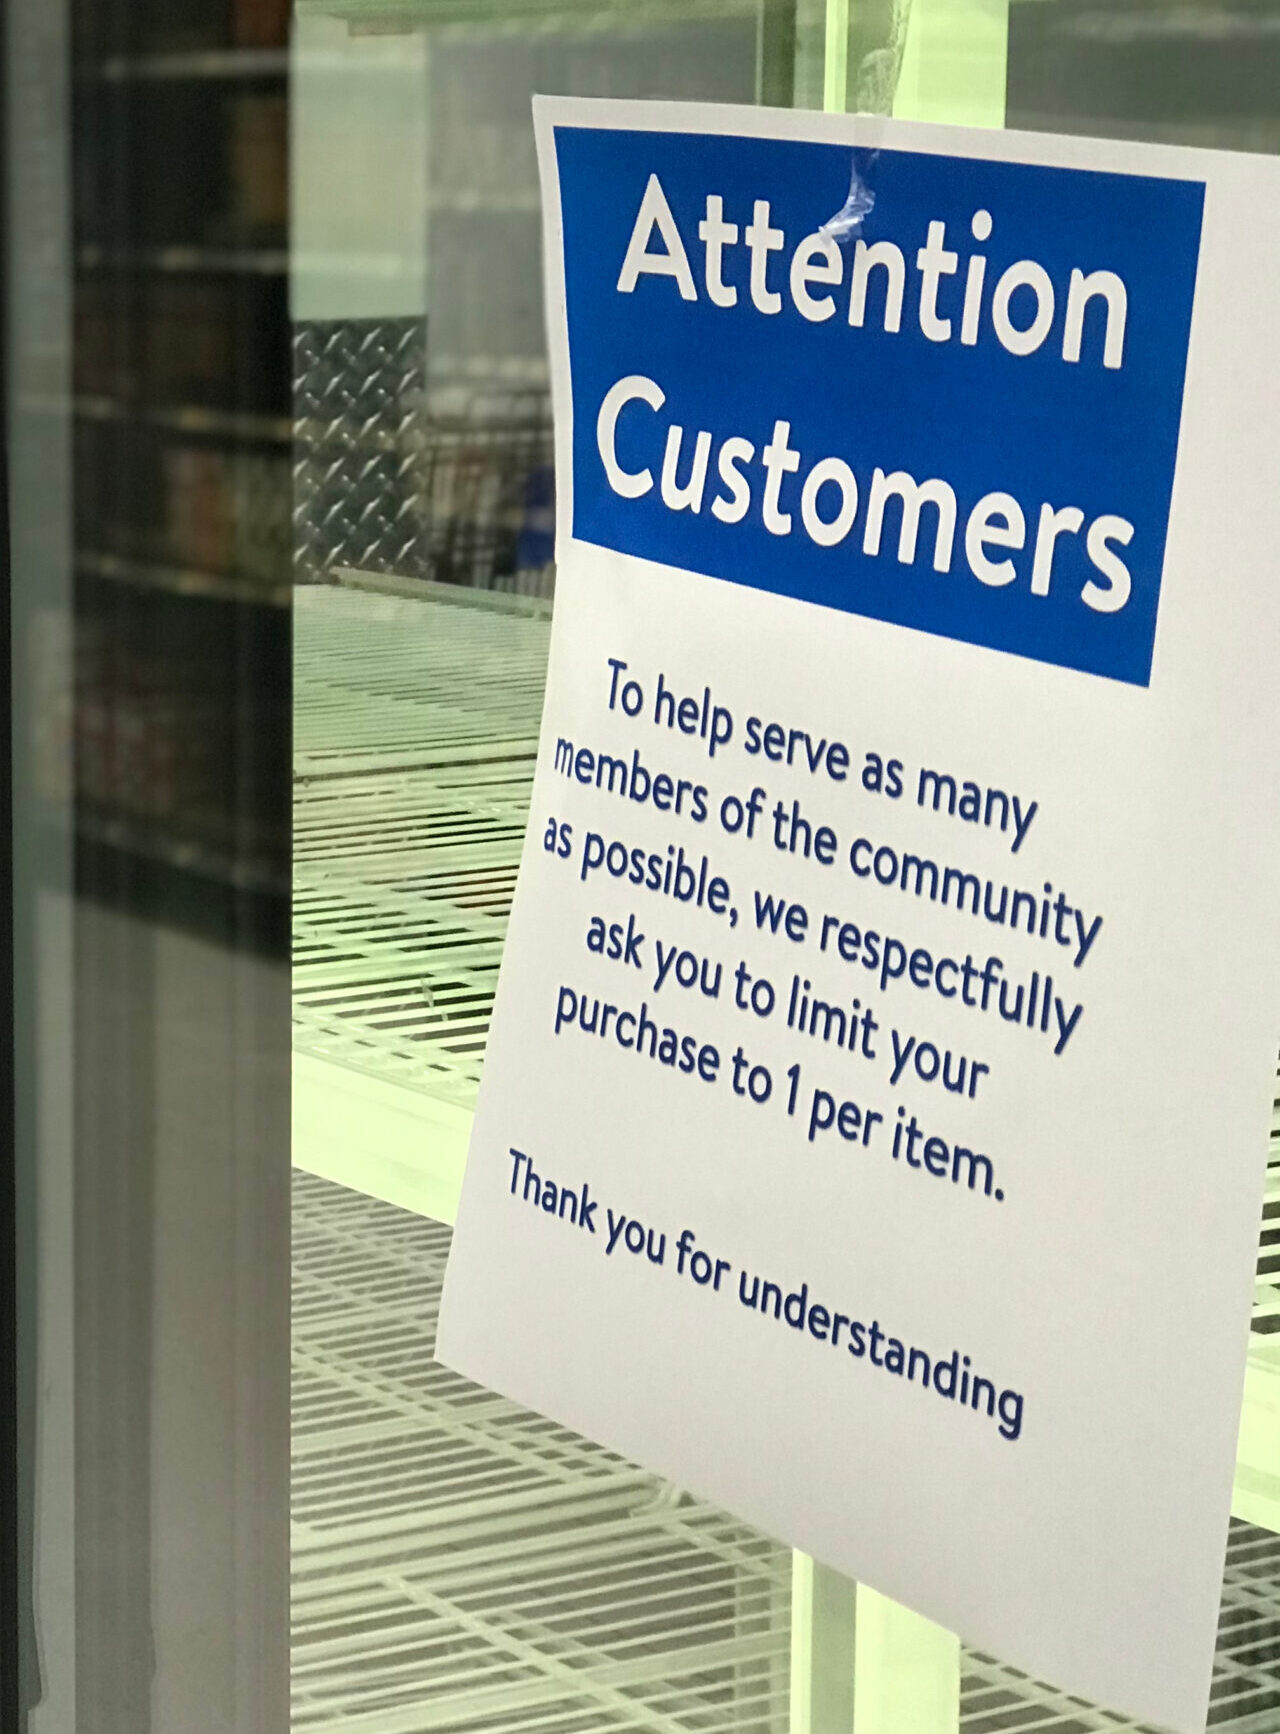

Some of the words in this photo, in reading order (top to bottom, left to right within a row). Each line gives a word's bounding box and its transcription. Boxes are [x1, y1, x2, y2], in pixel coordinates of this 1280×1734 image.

[617, 173, 1128, 370] Attention
[596, 375, 1135, 613] Customers
[554, 736, 708, 823] members
[720, 788, 766, 838] of
[773, 800, 838, 865] the
[849, 837, 1104, 967] community
[608, 657, 643, 717] To
[653, 673, 734, 757] help
[744, 715, 850, 781] serve
[861, 752, 904, 798] as
[917, 767, 1038, 853] many
[543, 817, 572, 858] as
[581, 830, 740, 927] possible,
[753, 889, 808, 942] we
[820, 913, 1083, 1055] respectfully
[587, 914, 646, 968] ask
[652, 939, 722, 998] you
[734, 961, 776, 1017] to
[786, 974, 879, 1060] limit
[889, 1029, 990, 1098] your
[554, 985, 721, 1083] purchase
[732, 1047, 772, 1103] to
[786, 1064, 801, 1116] 1
[808, 1088, 883, 1147] per
[891, 1106, 1006, 1202] item.
[508, 1148, 599, 1234] Thank
[604, 1208, 666, 1266] you
[675, 1230, 731, 1292] for
[738, 1270, 1024, 1441] understanding
